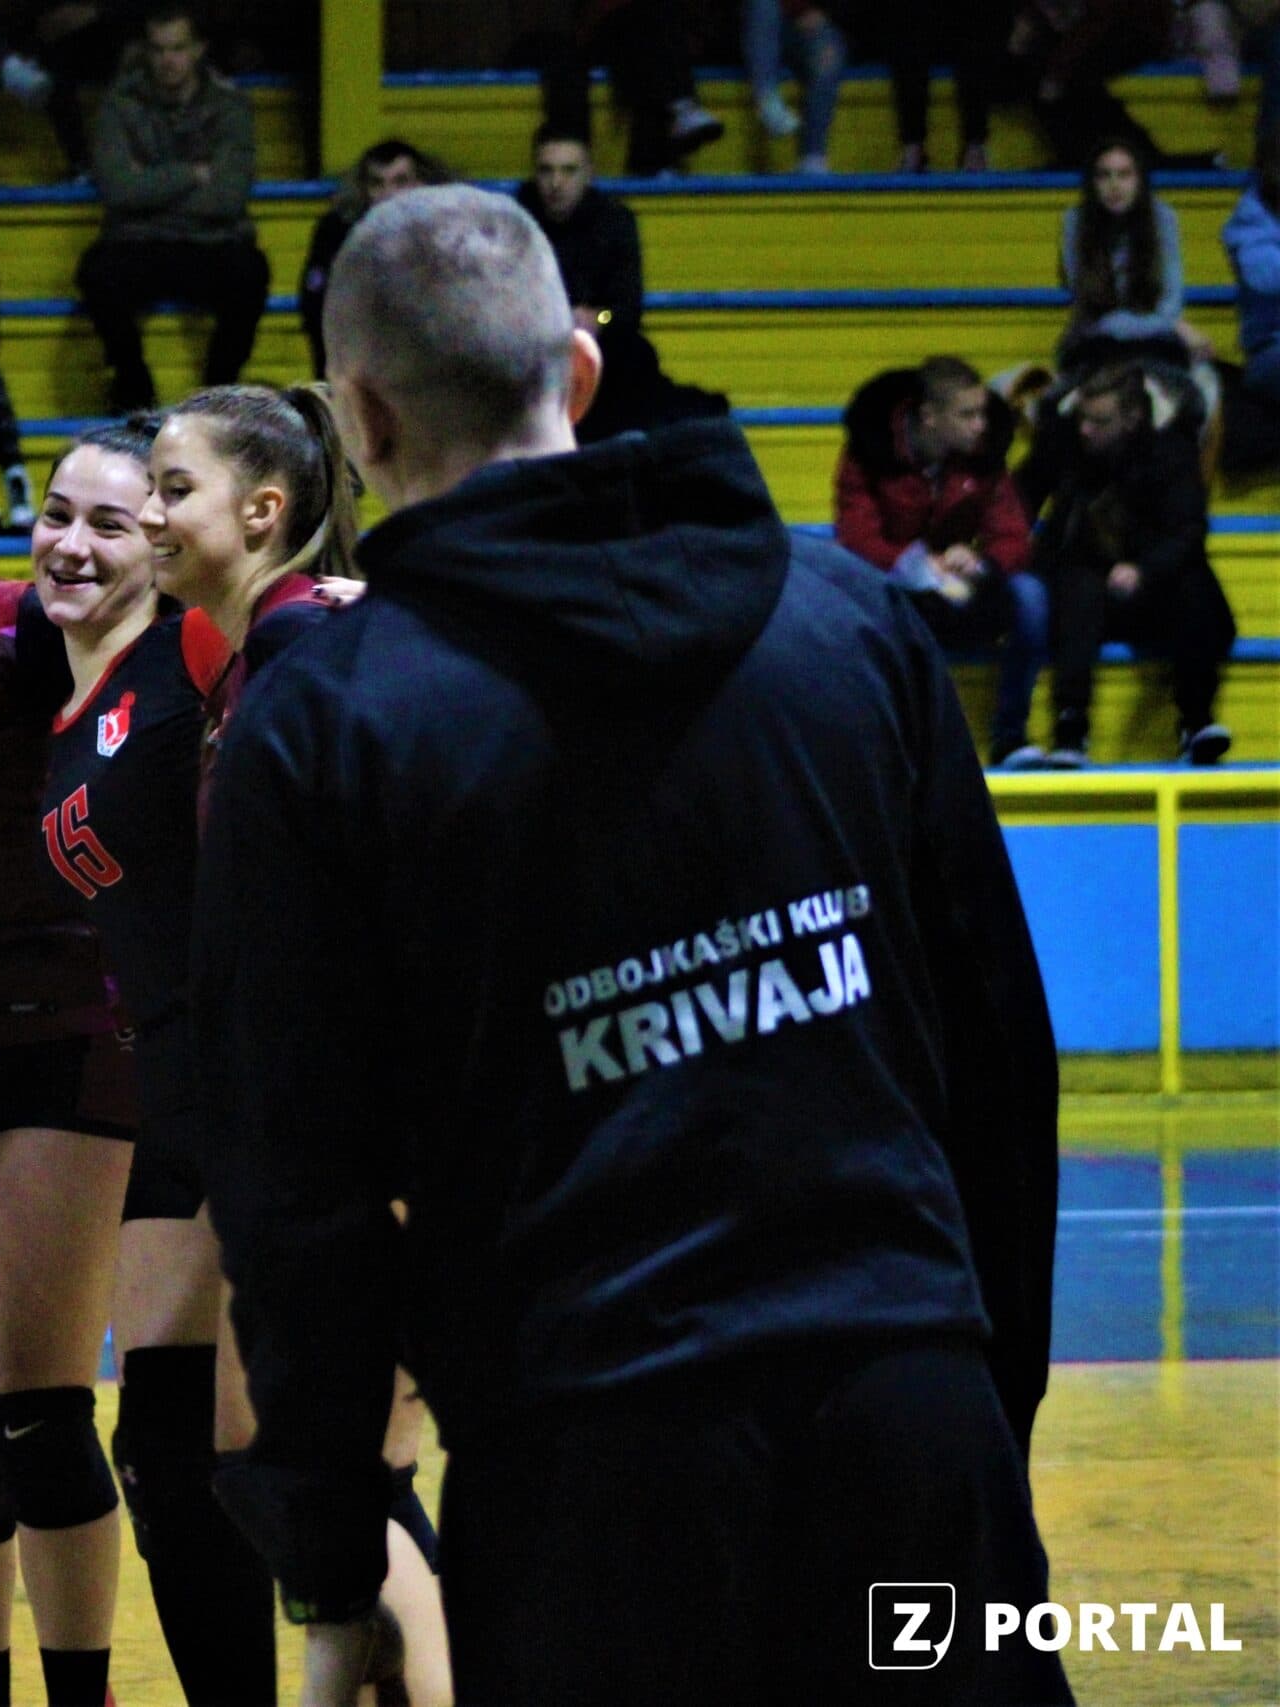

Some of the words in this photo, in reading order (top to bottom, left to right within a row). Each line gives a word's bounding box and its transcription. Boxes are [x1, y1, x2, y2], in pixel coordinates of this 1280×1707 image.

[41, 783, 123, 900] 15
[543, 907, 783, 1018] ODBOJKAŠKI
[787, 884, 871, 940] KLUB
[559, 932, 872, 1093] KRIVAJA
